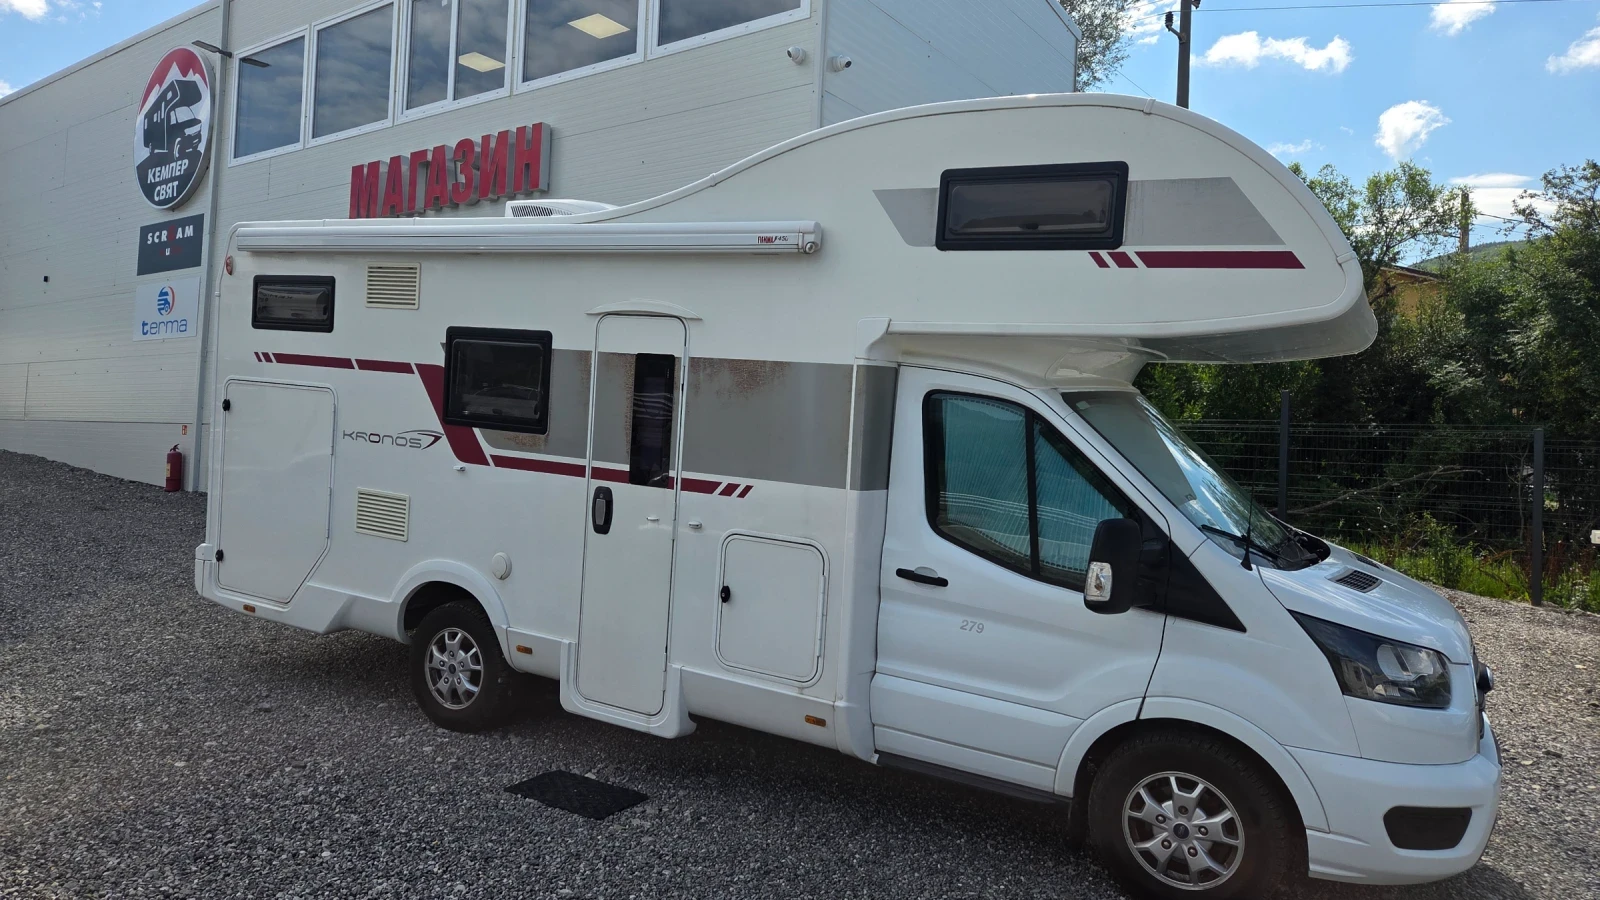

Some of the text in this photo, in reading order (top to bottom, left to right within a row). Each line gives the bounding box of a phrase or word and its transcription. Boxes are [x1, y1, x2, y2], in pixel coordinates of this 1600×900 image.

[147, 160, 189, 184] КЕМПЕР
[349, 122, 545, 219] МАГАЗИН
[154, 181, 179, 202] СВЯТ
[147, 225, 194, 245] SCRAM
[141, 318, 188, 336] terma
[342, 430, 422, 449] KRONOS
[960, 619, 985, 634] 279
